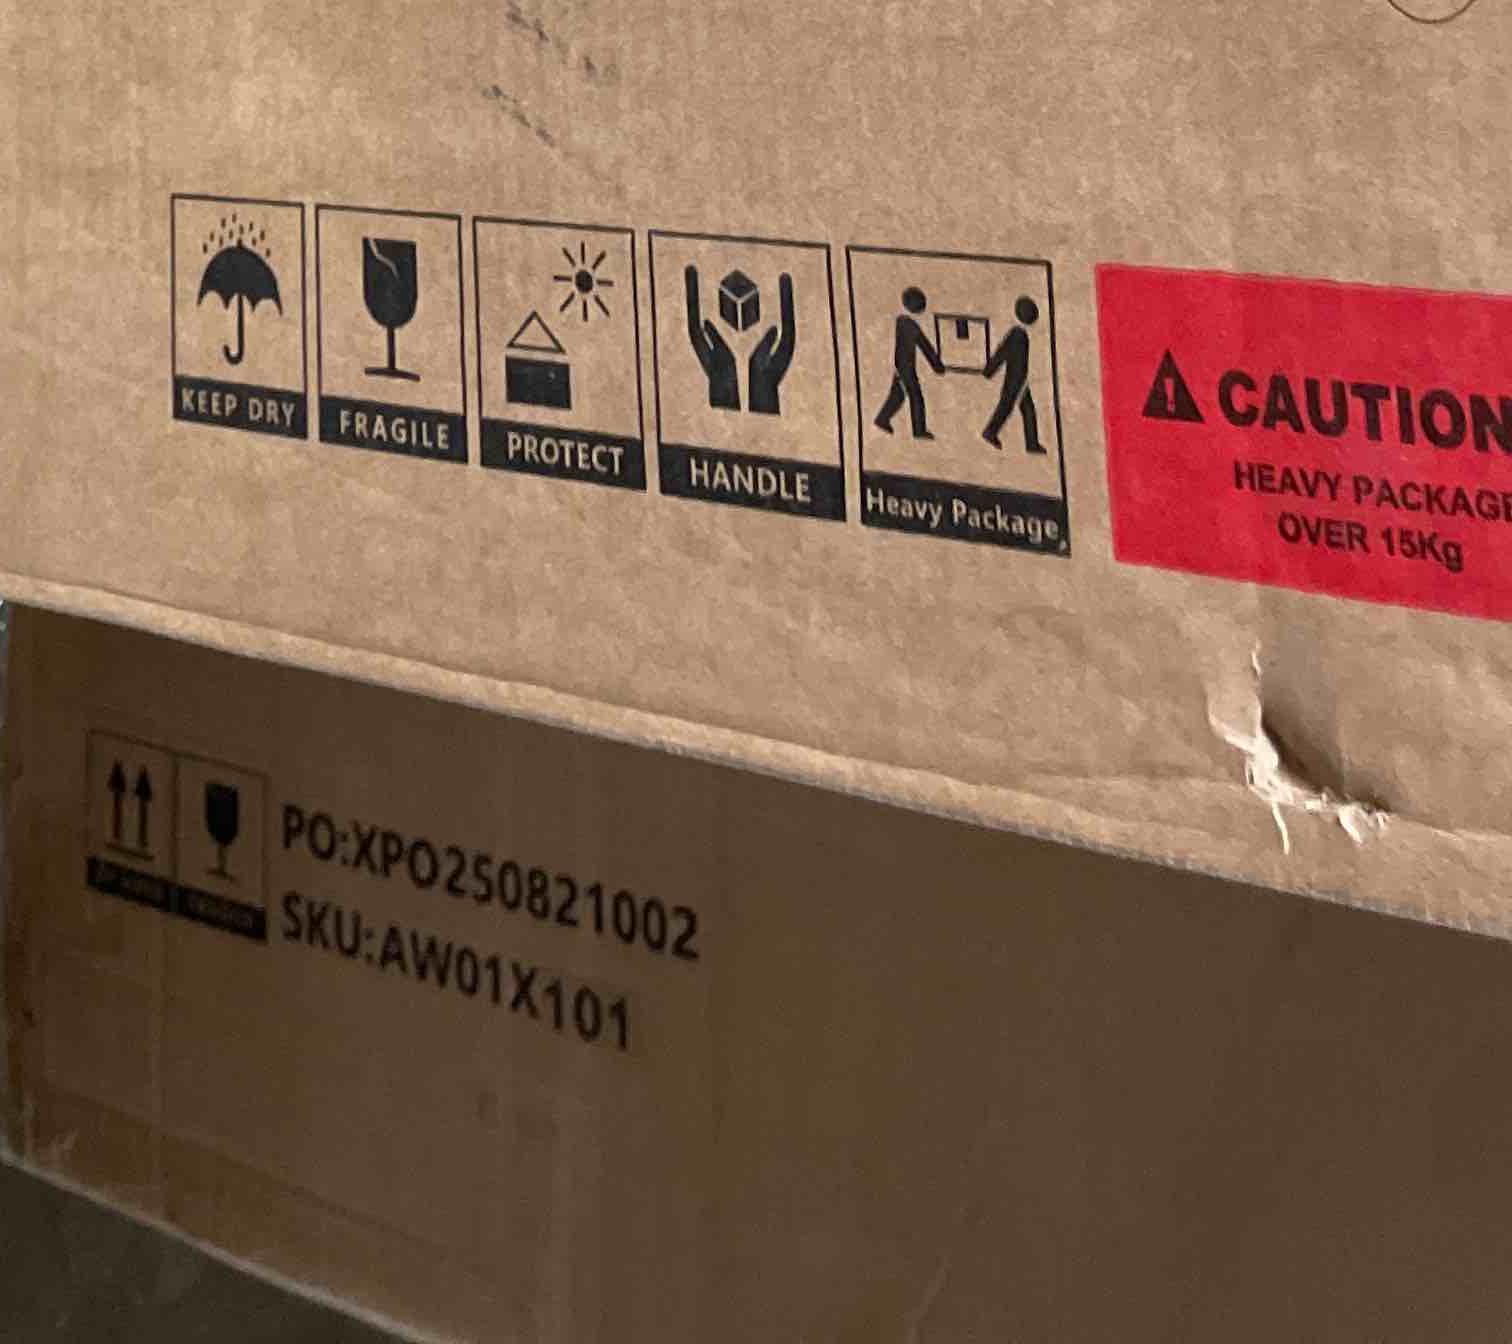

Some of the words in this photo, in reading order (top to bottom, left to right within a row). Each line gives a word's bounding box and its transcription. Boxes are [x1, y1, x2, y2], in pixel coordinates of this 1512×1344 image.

[181, 387, 238, 416] KEEP
[248, 400, 295, 429] DRY
[339, 409, 449, 449] FRAGILE
[506, 431, 624, 475] PROTECT
[689, 457, 811, 502] HANDLE
[1234, 460, 1342, 502] HEAVY
[865, 488, 942, 528] Heavy
[1278, 512, 1371, 555] OVER
[1380, 526, 1465, 574] 15Kg
[281, 892, 631, 1051] SKU:AW01X101
